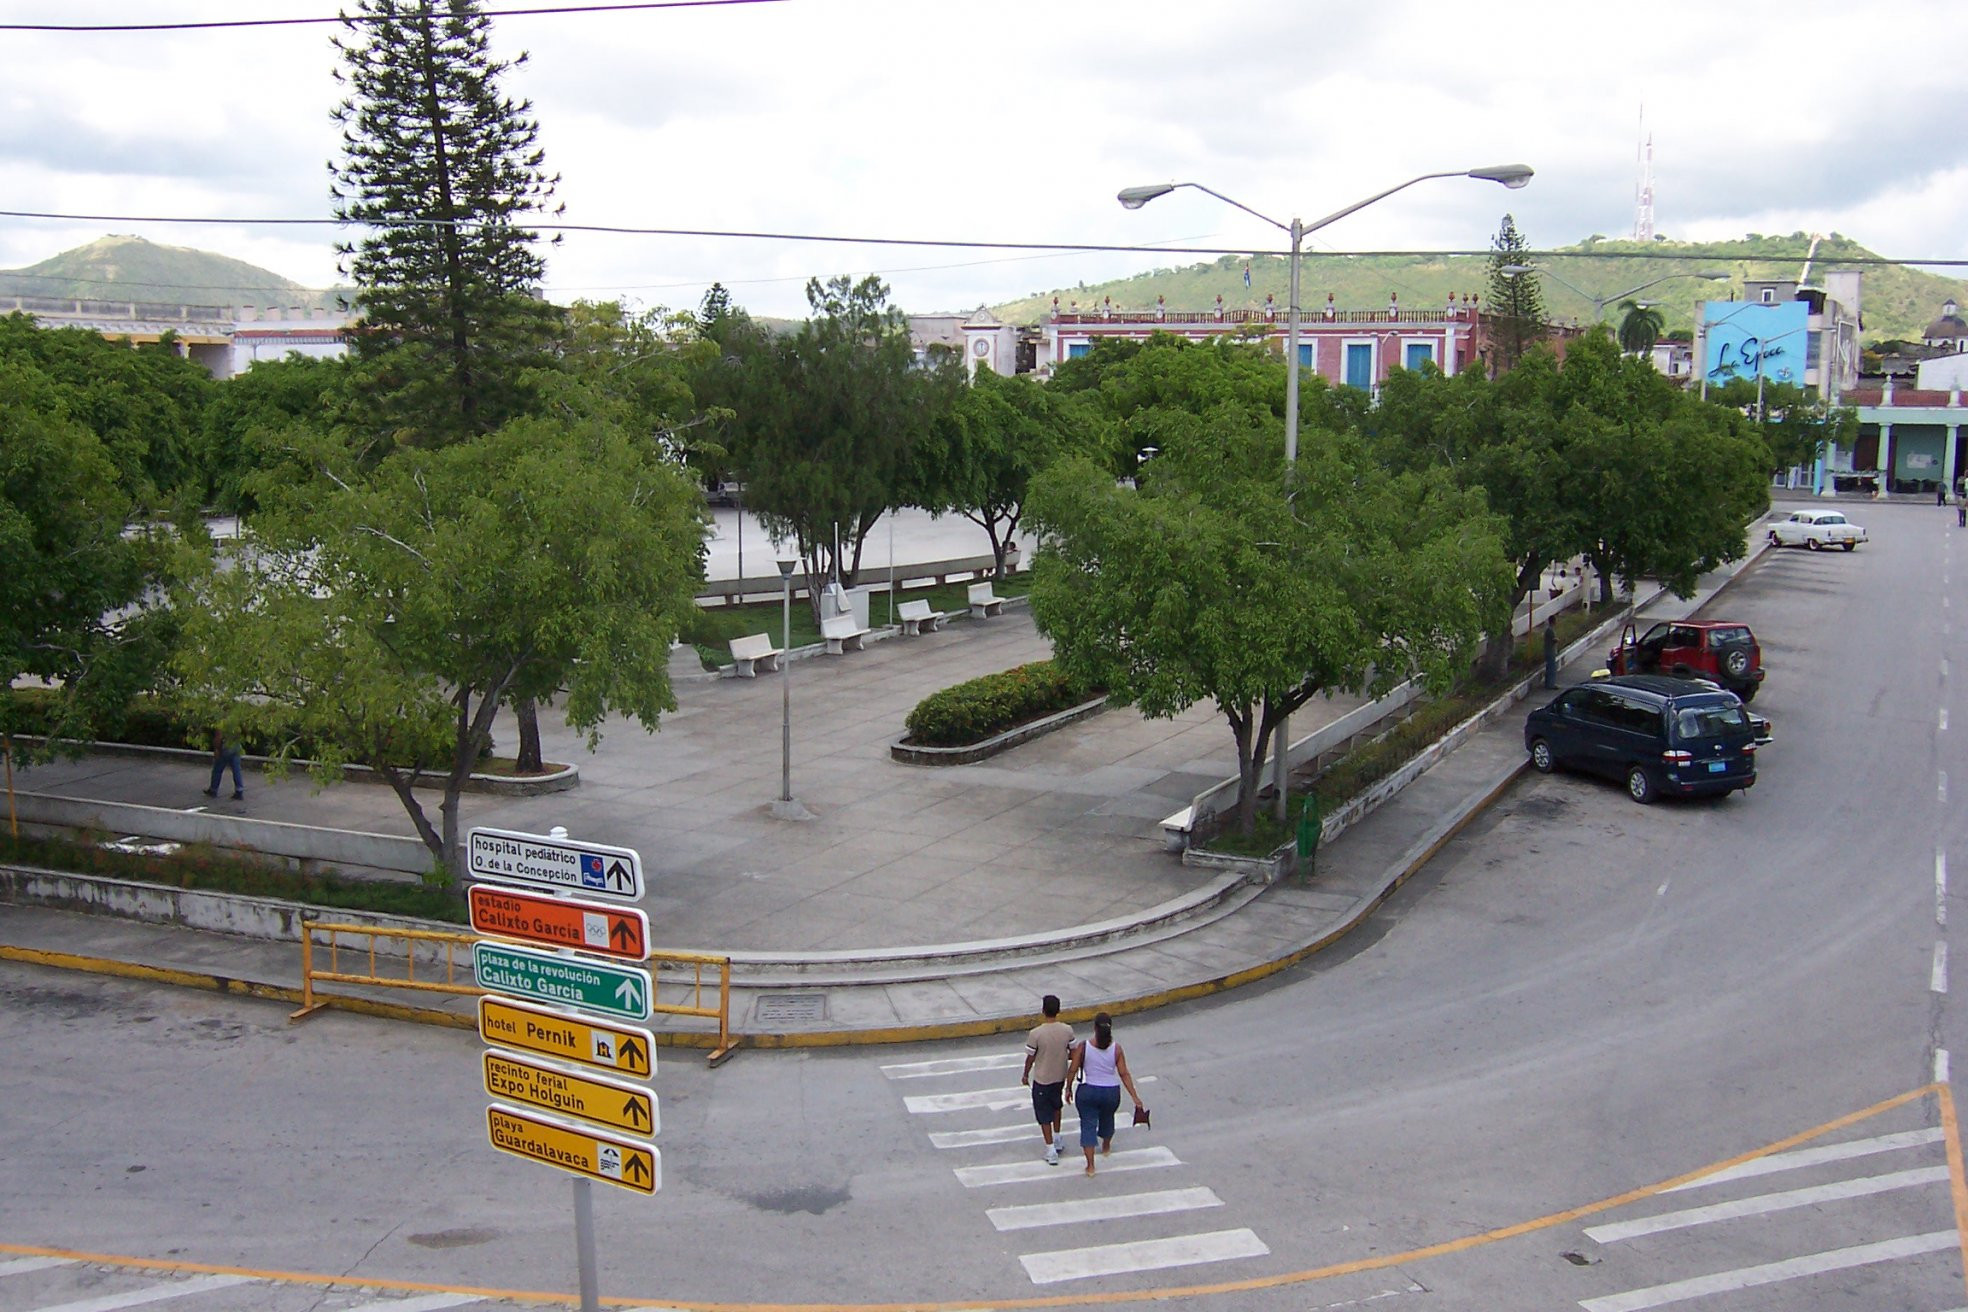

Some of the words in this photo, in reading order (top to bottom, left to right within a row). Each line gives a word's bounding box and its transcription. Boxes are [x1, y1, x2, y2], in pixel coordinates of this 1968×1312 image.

[475, 837, 521, 856] hospital
[488, 859, 500, 869] de
[503, 860, 512, 871] la
[517, 862, 577, 882] Concepción
[478, 896, 521, 912] estadio
[478, 909, 529, 931] Calixto
[481, 953, 510, 968] plaza
[512, 958, 526, 971] de
[527, 960, 539, 973] la
[540, 966, 600, 986] revolución
[482, 967, 532, 990] Calixto
[537, 978, 584, 1000] García
[487, 1016, 516, 1034] hotel
[527, 1022, 577, 1048] Pernik
[490, 1062, 530, 1080] recinto
[536, 1072, 568, 1091] ferial
[491, 1072, 525, 1094] Expo
[493, 1116, 523, 1133] playa
[494, 1129, 589, 1168] Guardalavaca
